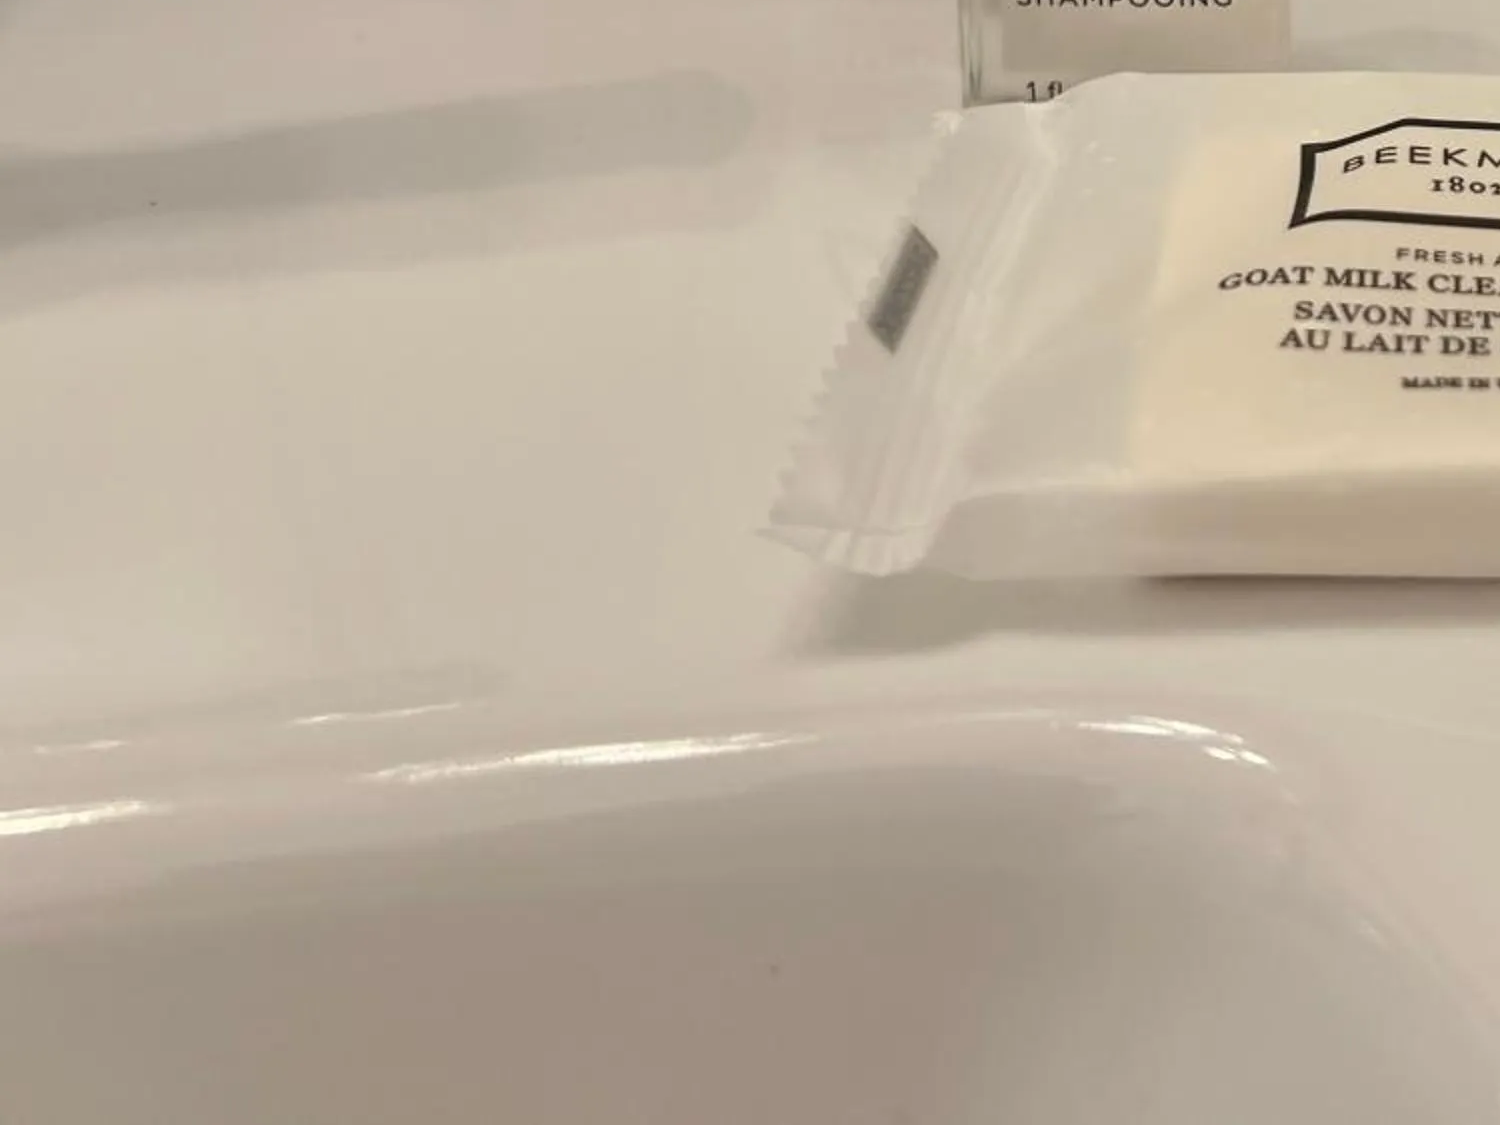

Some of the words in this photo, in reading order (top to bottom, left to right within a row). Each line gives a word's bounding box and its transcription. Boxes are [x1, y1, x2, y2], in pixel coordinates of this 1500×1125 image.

[1396, 247, 1485, 267] FRESH
[1218, 265, 1314, 292] GOAT
[1323, 268, 1417, 293] MILK
[1294, 300, 1413, 327] SAVON
[1279, 328, 1330, 351] AU
[1342, 330, 1430, 355] LAIT
[1441, 335, 1492, 357] DE
